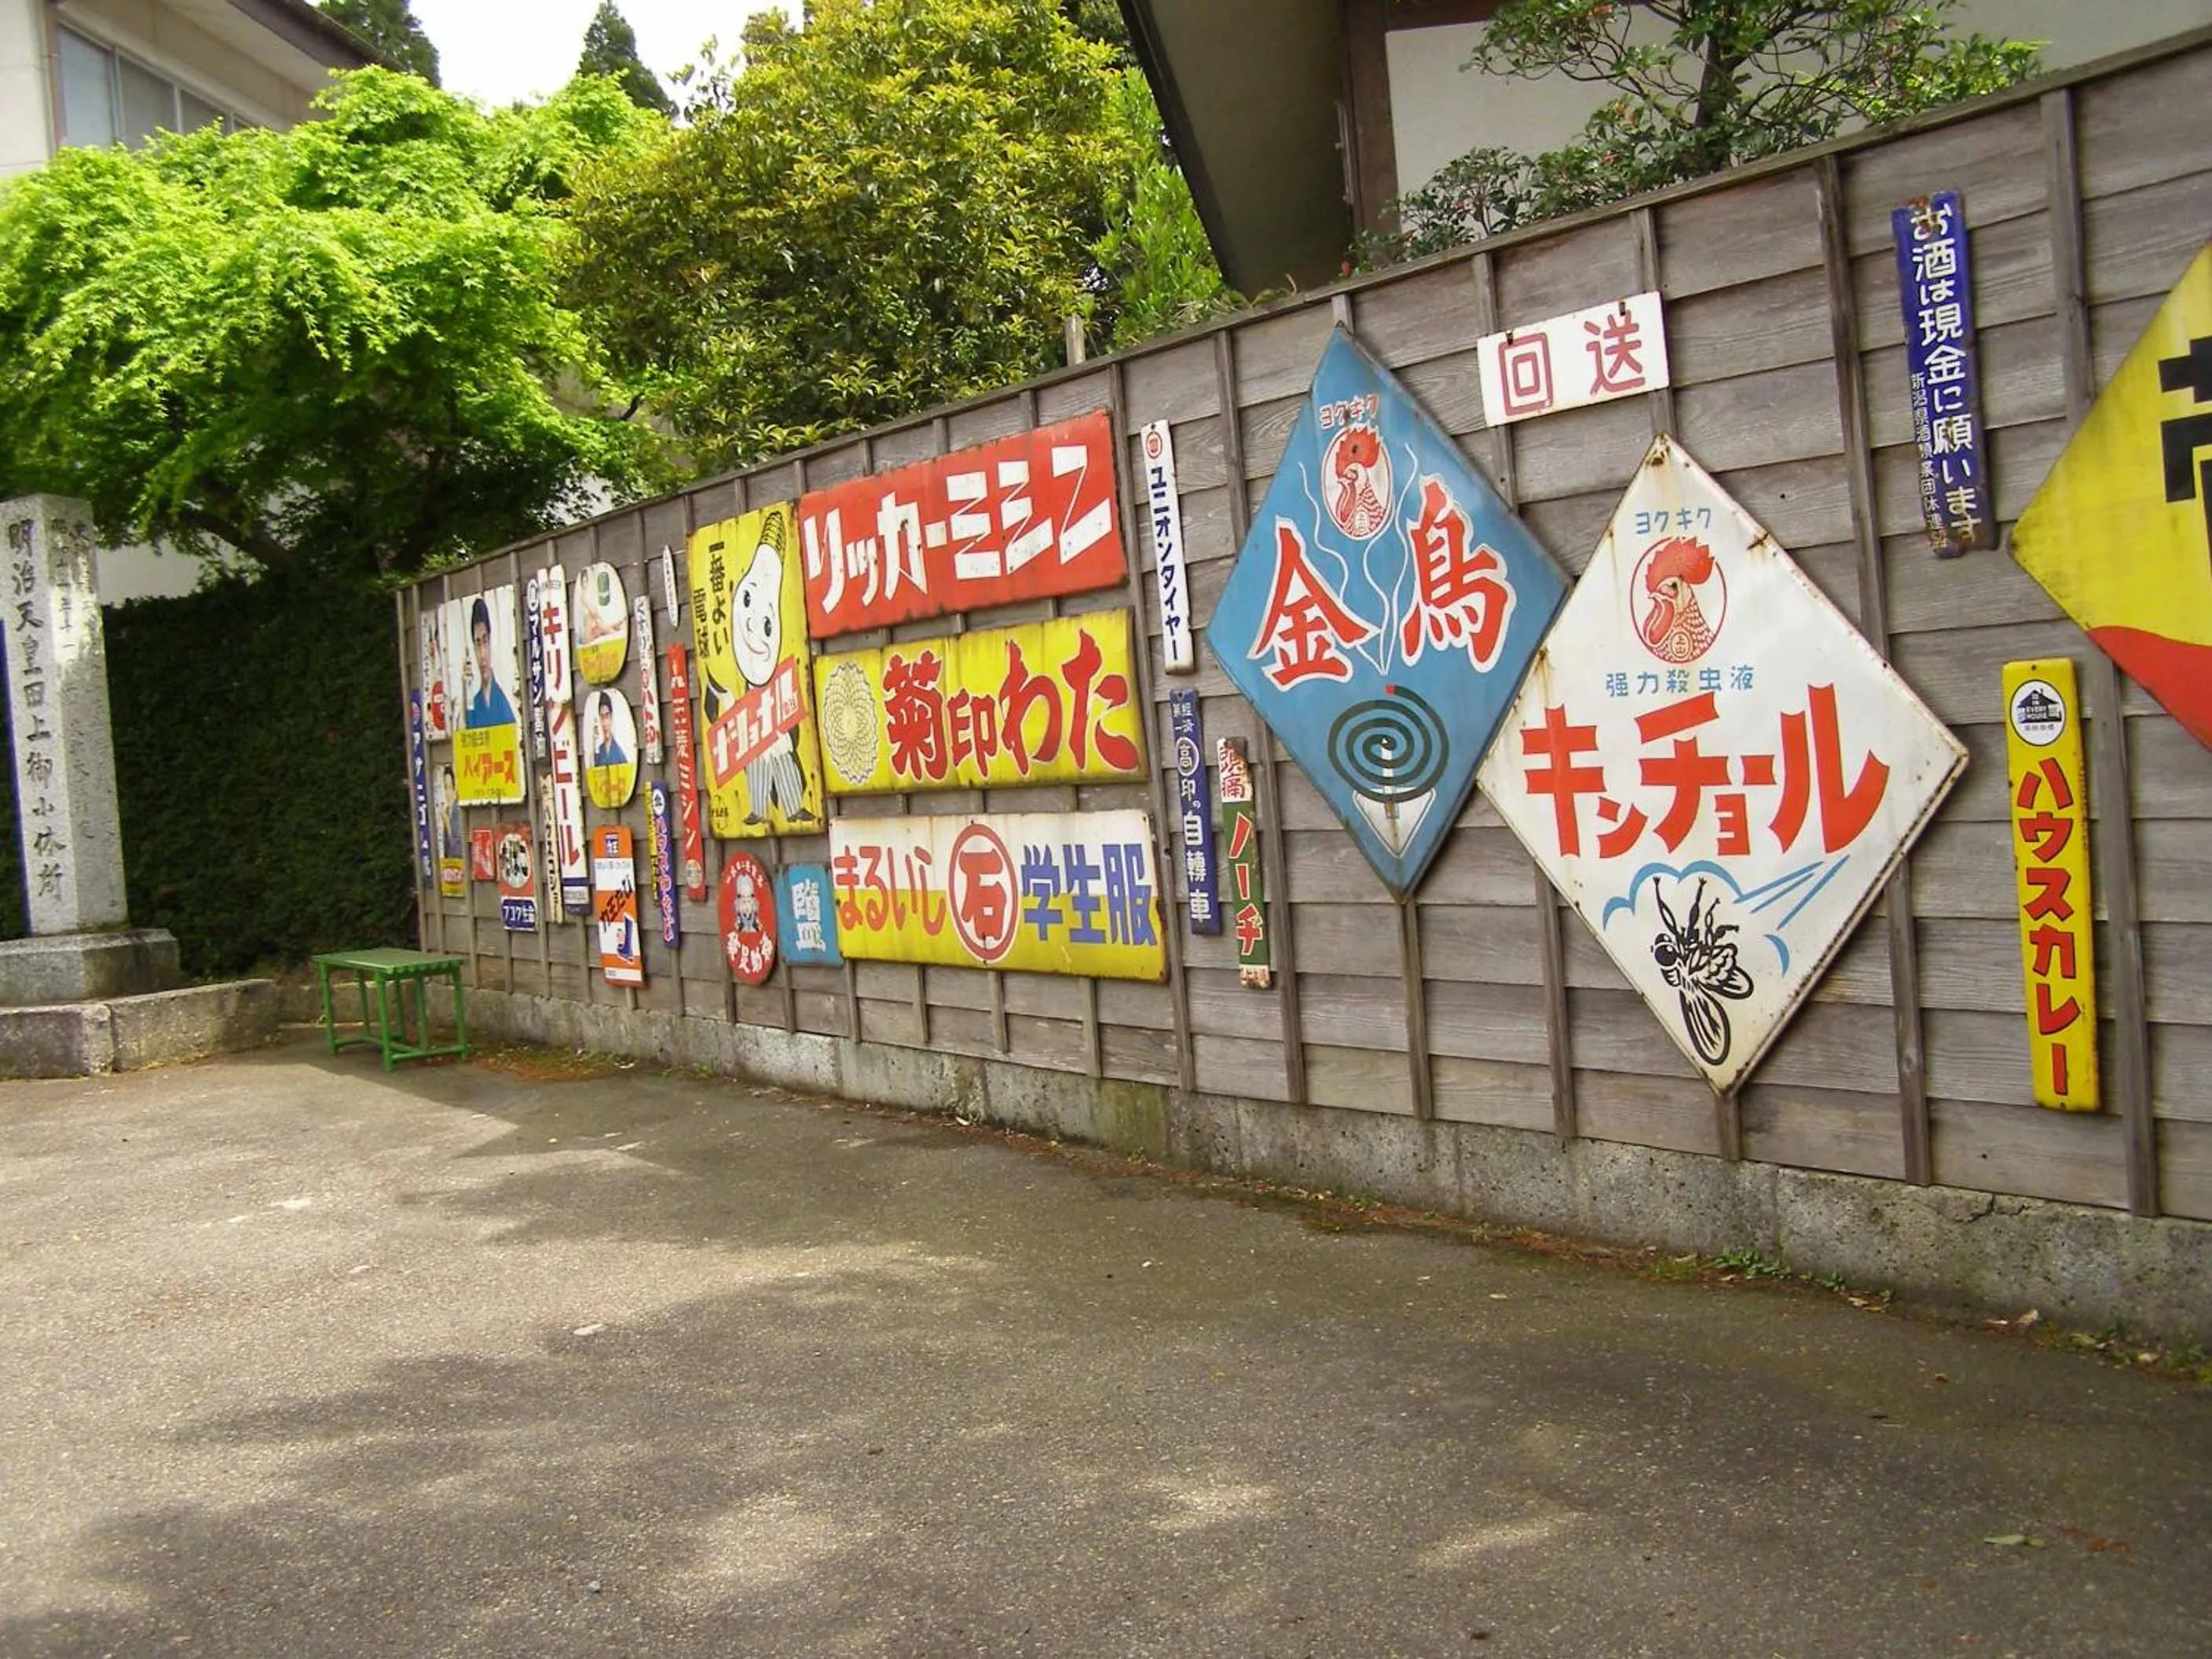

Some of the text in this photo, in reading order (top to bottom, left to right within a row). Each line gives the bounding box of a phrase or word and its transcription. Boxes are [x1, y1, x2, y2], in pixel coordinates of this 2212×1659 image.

[1320, 394, 1379, 430] ヨクキク
[1498, 309, 1646, 416] 回送
[1910, 203, 1984, 542] お酒は現金に願います
[803, 444, 1112, 614] リッカーミシン
[1151, 467, 1181, 661] ユニオンタイヤー
[1251, 478, 1514, 689] 金鳥
[1635, 507, 1712, 535] ヨクキク
[709, 540, 729, 656] 一番よい
[712, 668, 798, 776] ナショナル
[881, 626, 1140, 782] 菊印わた
[1519, 683, 1891, 859] キンチョール
[833, 843, 947, 936] まるいし
[1020, 843, 1158, 947] 学生服
[1229, 811, 1263, 956] ノーチ
[2016, 756, 2081, 1096] ハウスカレー
